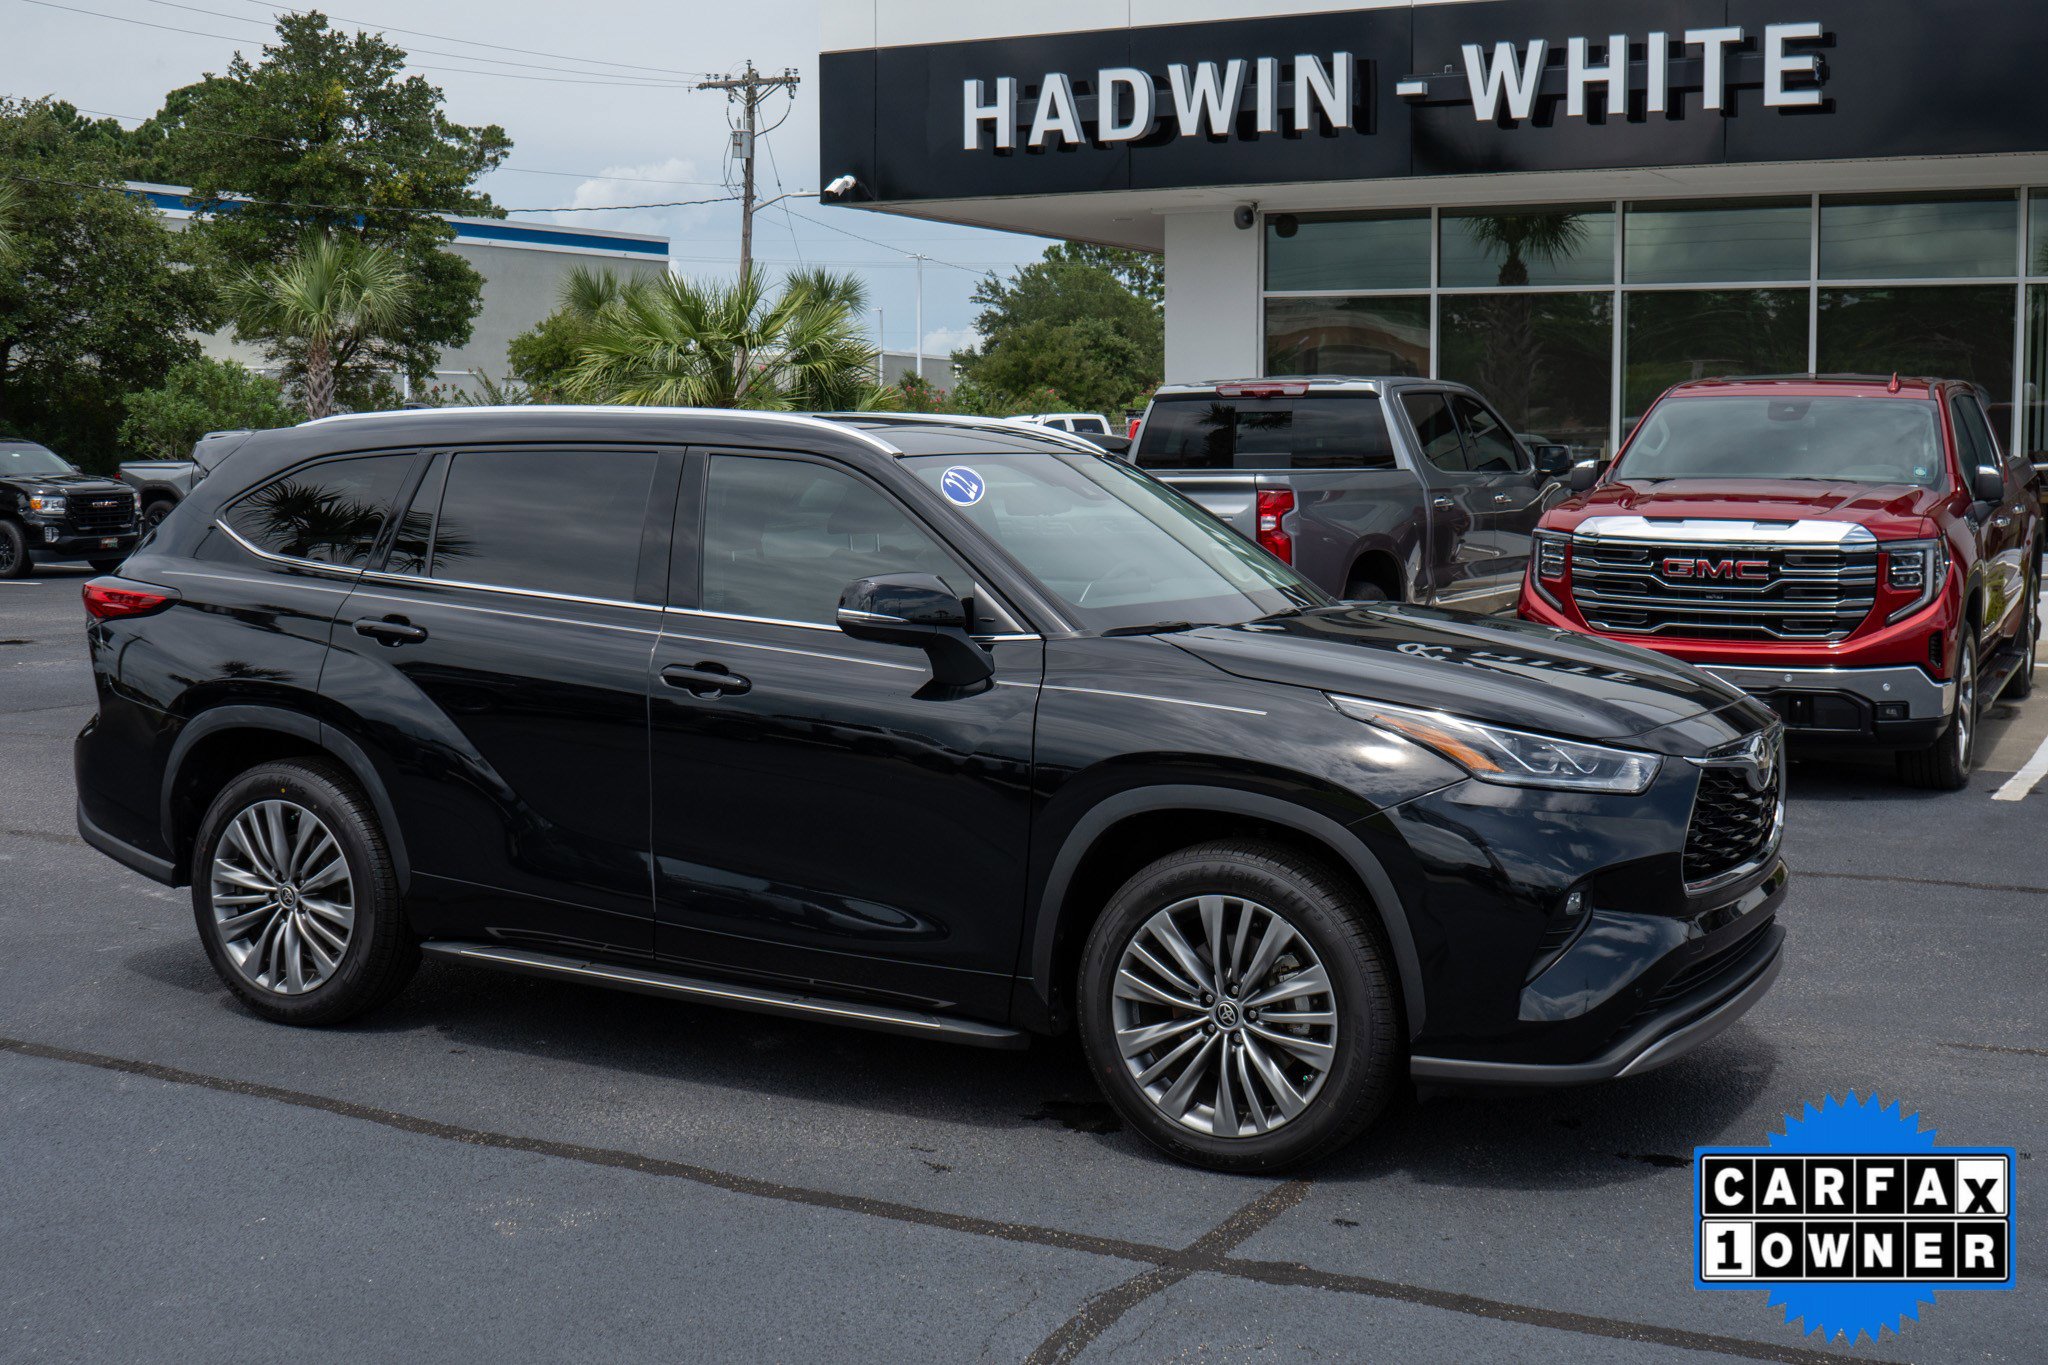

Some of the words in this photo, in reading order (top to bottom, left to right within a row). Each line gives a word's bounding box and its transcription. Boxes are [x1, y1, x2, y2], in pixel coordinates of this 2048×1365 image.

[963, 51, 1353, 150] HADWIN
[1461, 22, 1823, 121] WHITE
[1663, 557, 1769, 580] GMC
